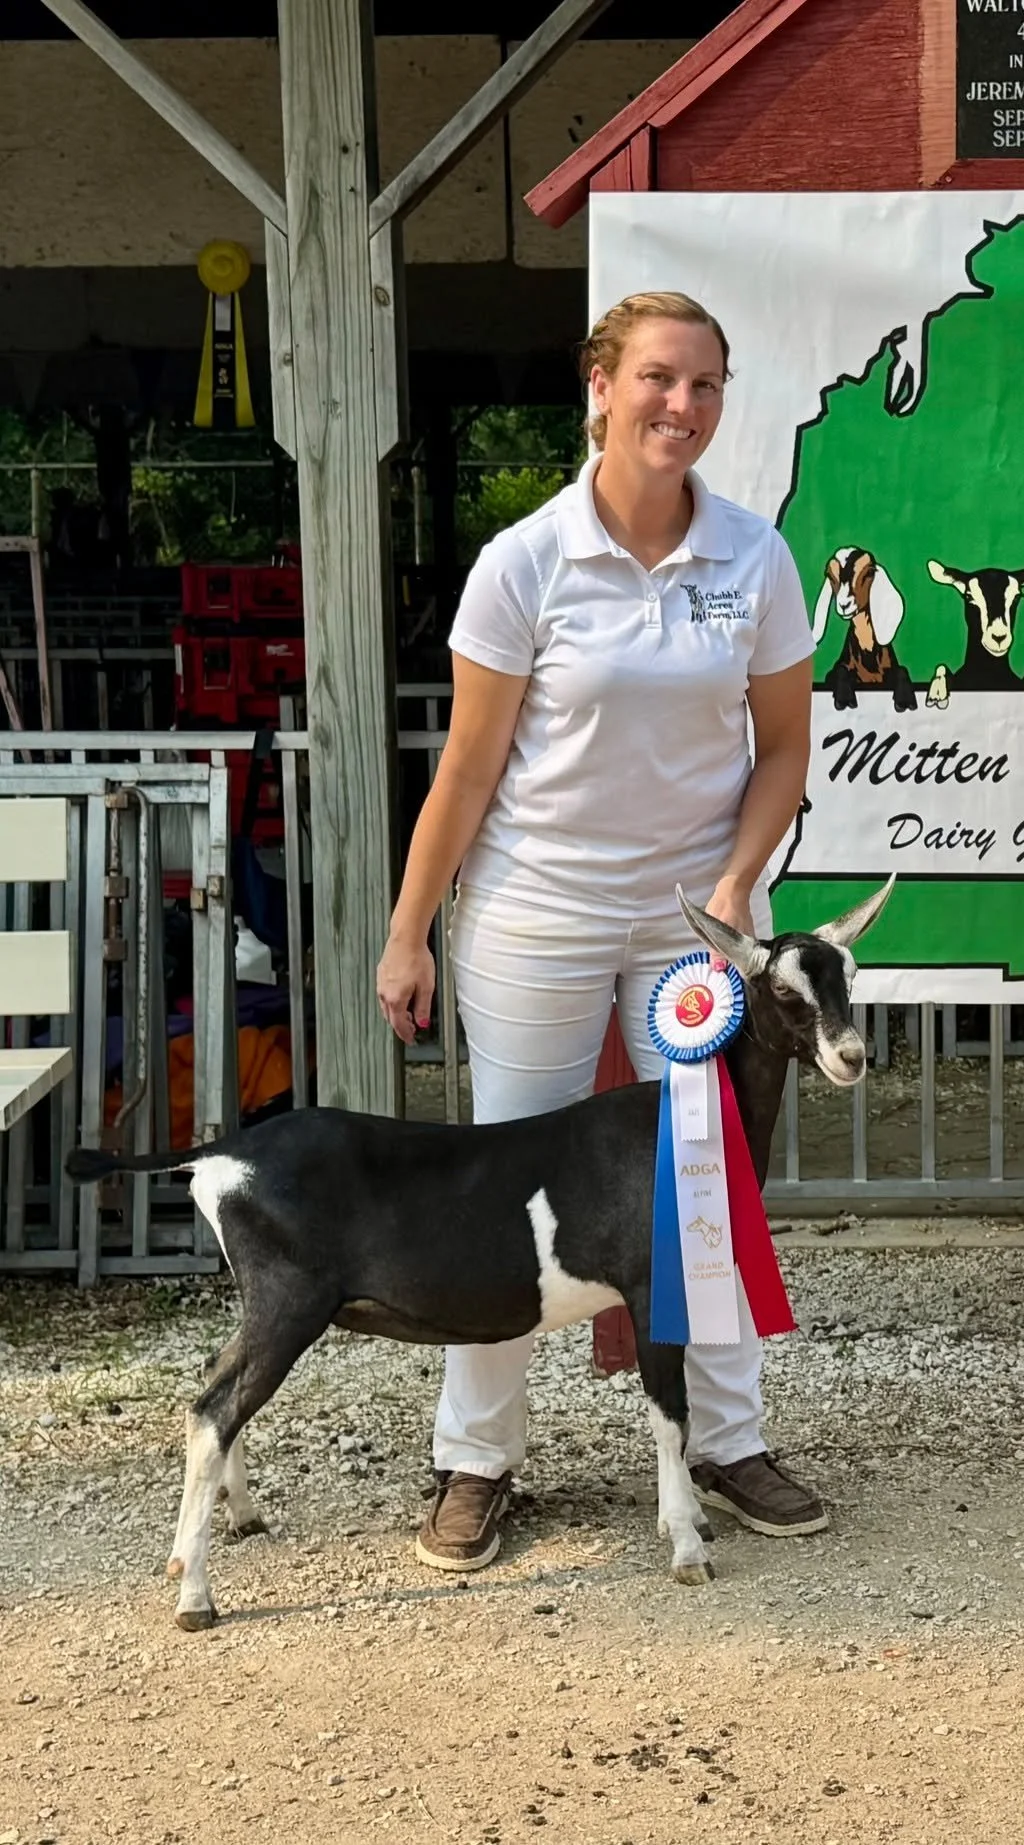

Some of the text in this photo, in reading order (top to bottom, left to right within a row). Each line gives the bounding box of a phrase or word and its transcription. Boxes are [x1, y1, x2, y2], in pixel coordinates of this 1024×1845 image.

[1009, 55, 1023, 68] IN
[707, 602, 733, 610] Acres
[822, 728, 1010, 786] Mitten
[886, 812, 997, 861] Dairy
[680, 1163, 721, 1177] ADGA
